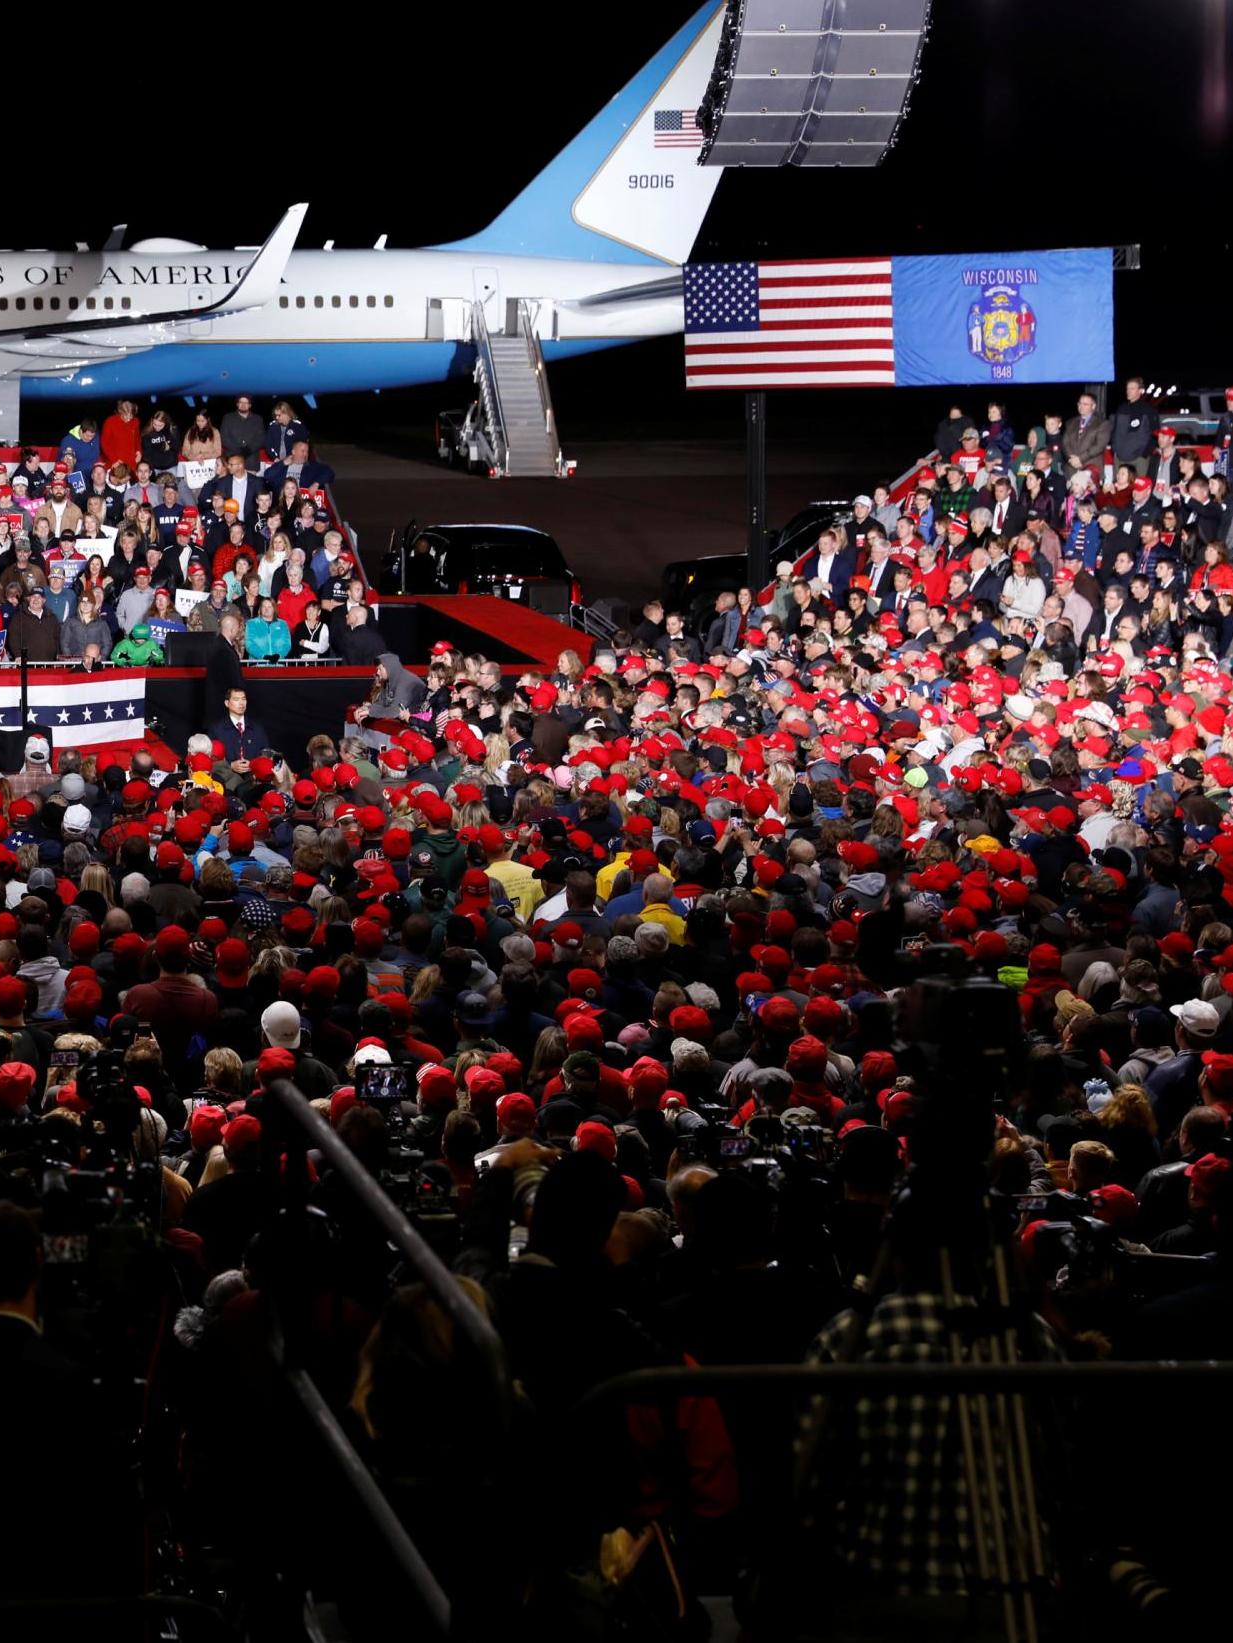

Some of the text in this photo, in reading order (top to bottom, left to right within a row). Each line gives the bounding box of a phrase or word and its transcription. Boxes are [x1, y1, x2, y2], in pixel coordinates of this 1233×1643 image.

[628, 174, 674, 189] 90016
[24, 265, 74, 286] OF
[962, 268, 1037, 286] WISCONSIN
[992, 365, 1012, 379] 1848
[159, 516, 180, 525] NAVY
